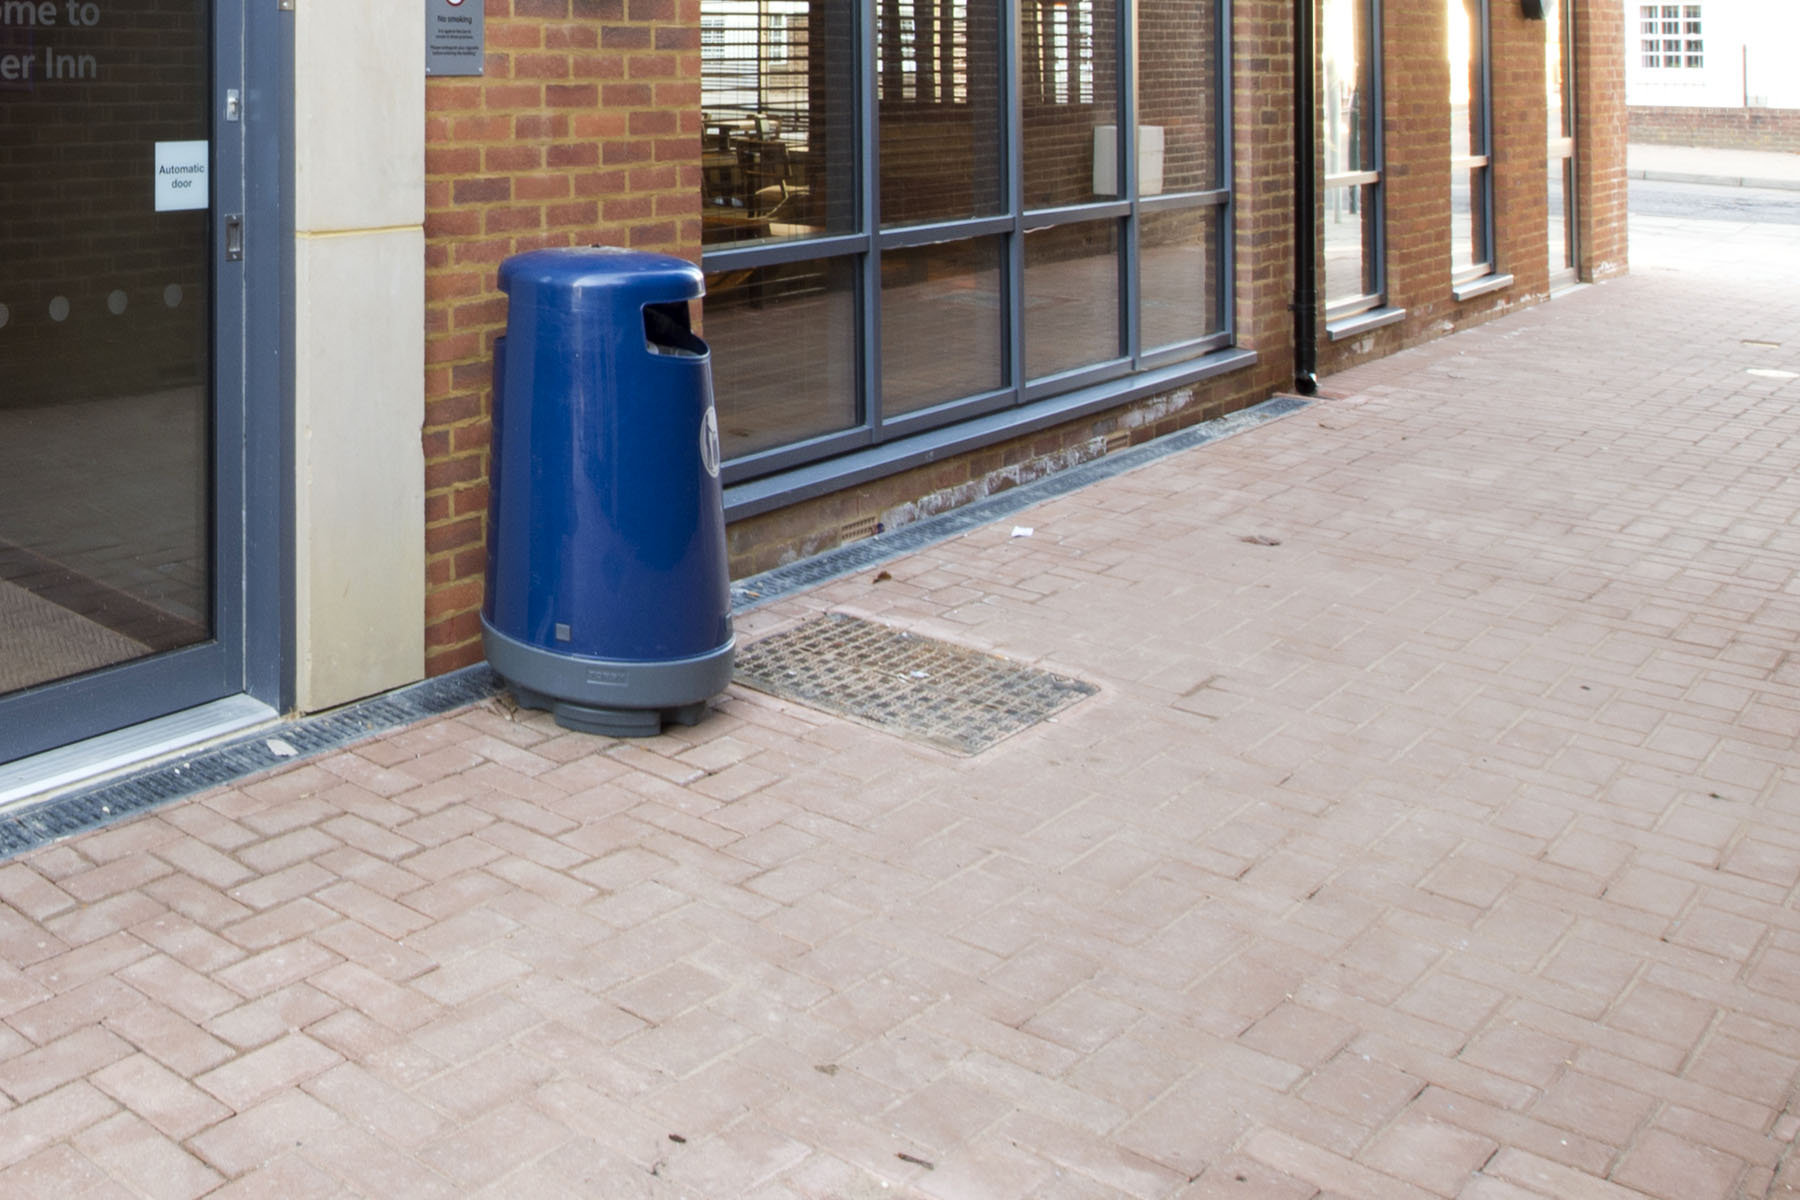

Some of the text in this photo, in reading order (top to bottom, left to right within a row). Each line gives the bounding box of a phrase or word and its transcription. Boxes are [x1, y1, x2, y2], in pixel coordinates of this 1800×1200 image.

[46, 46, 97, 79] Inn
[159, 163, 205, 175] Automatic
[171, 179, 193, 189] door
